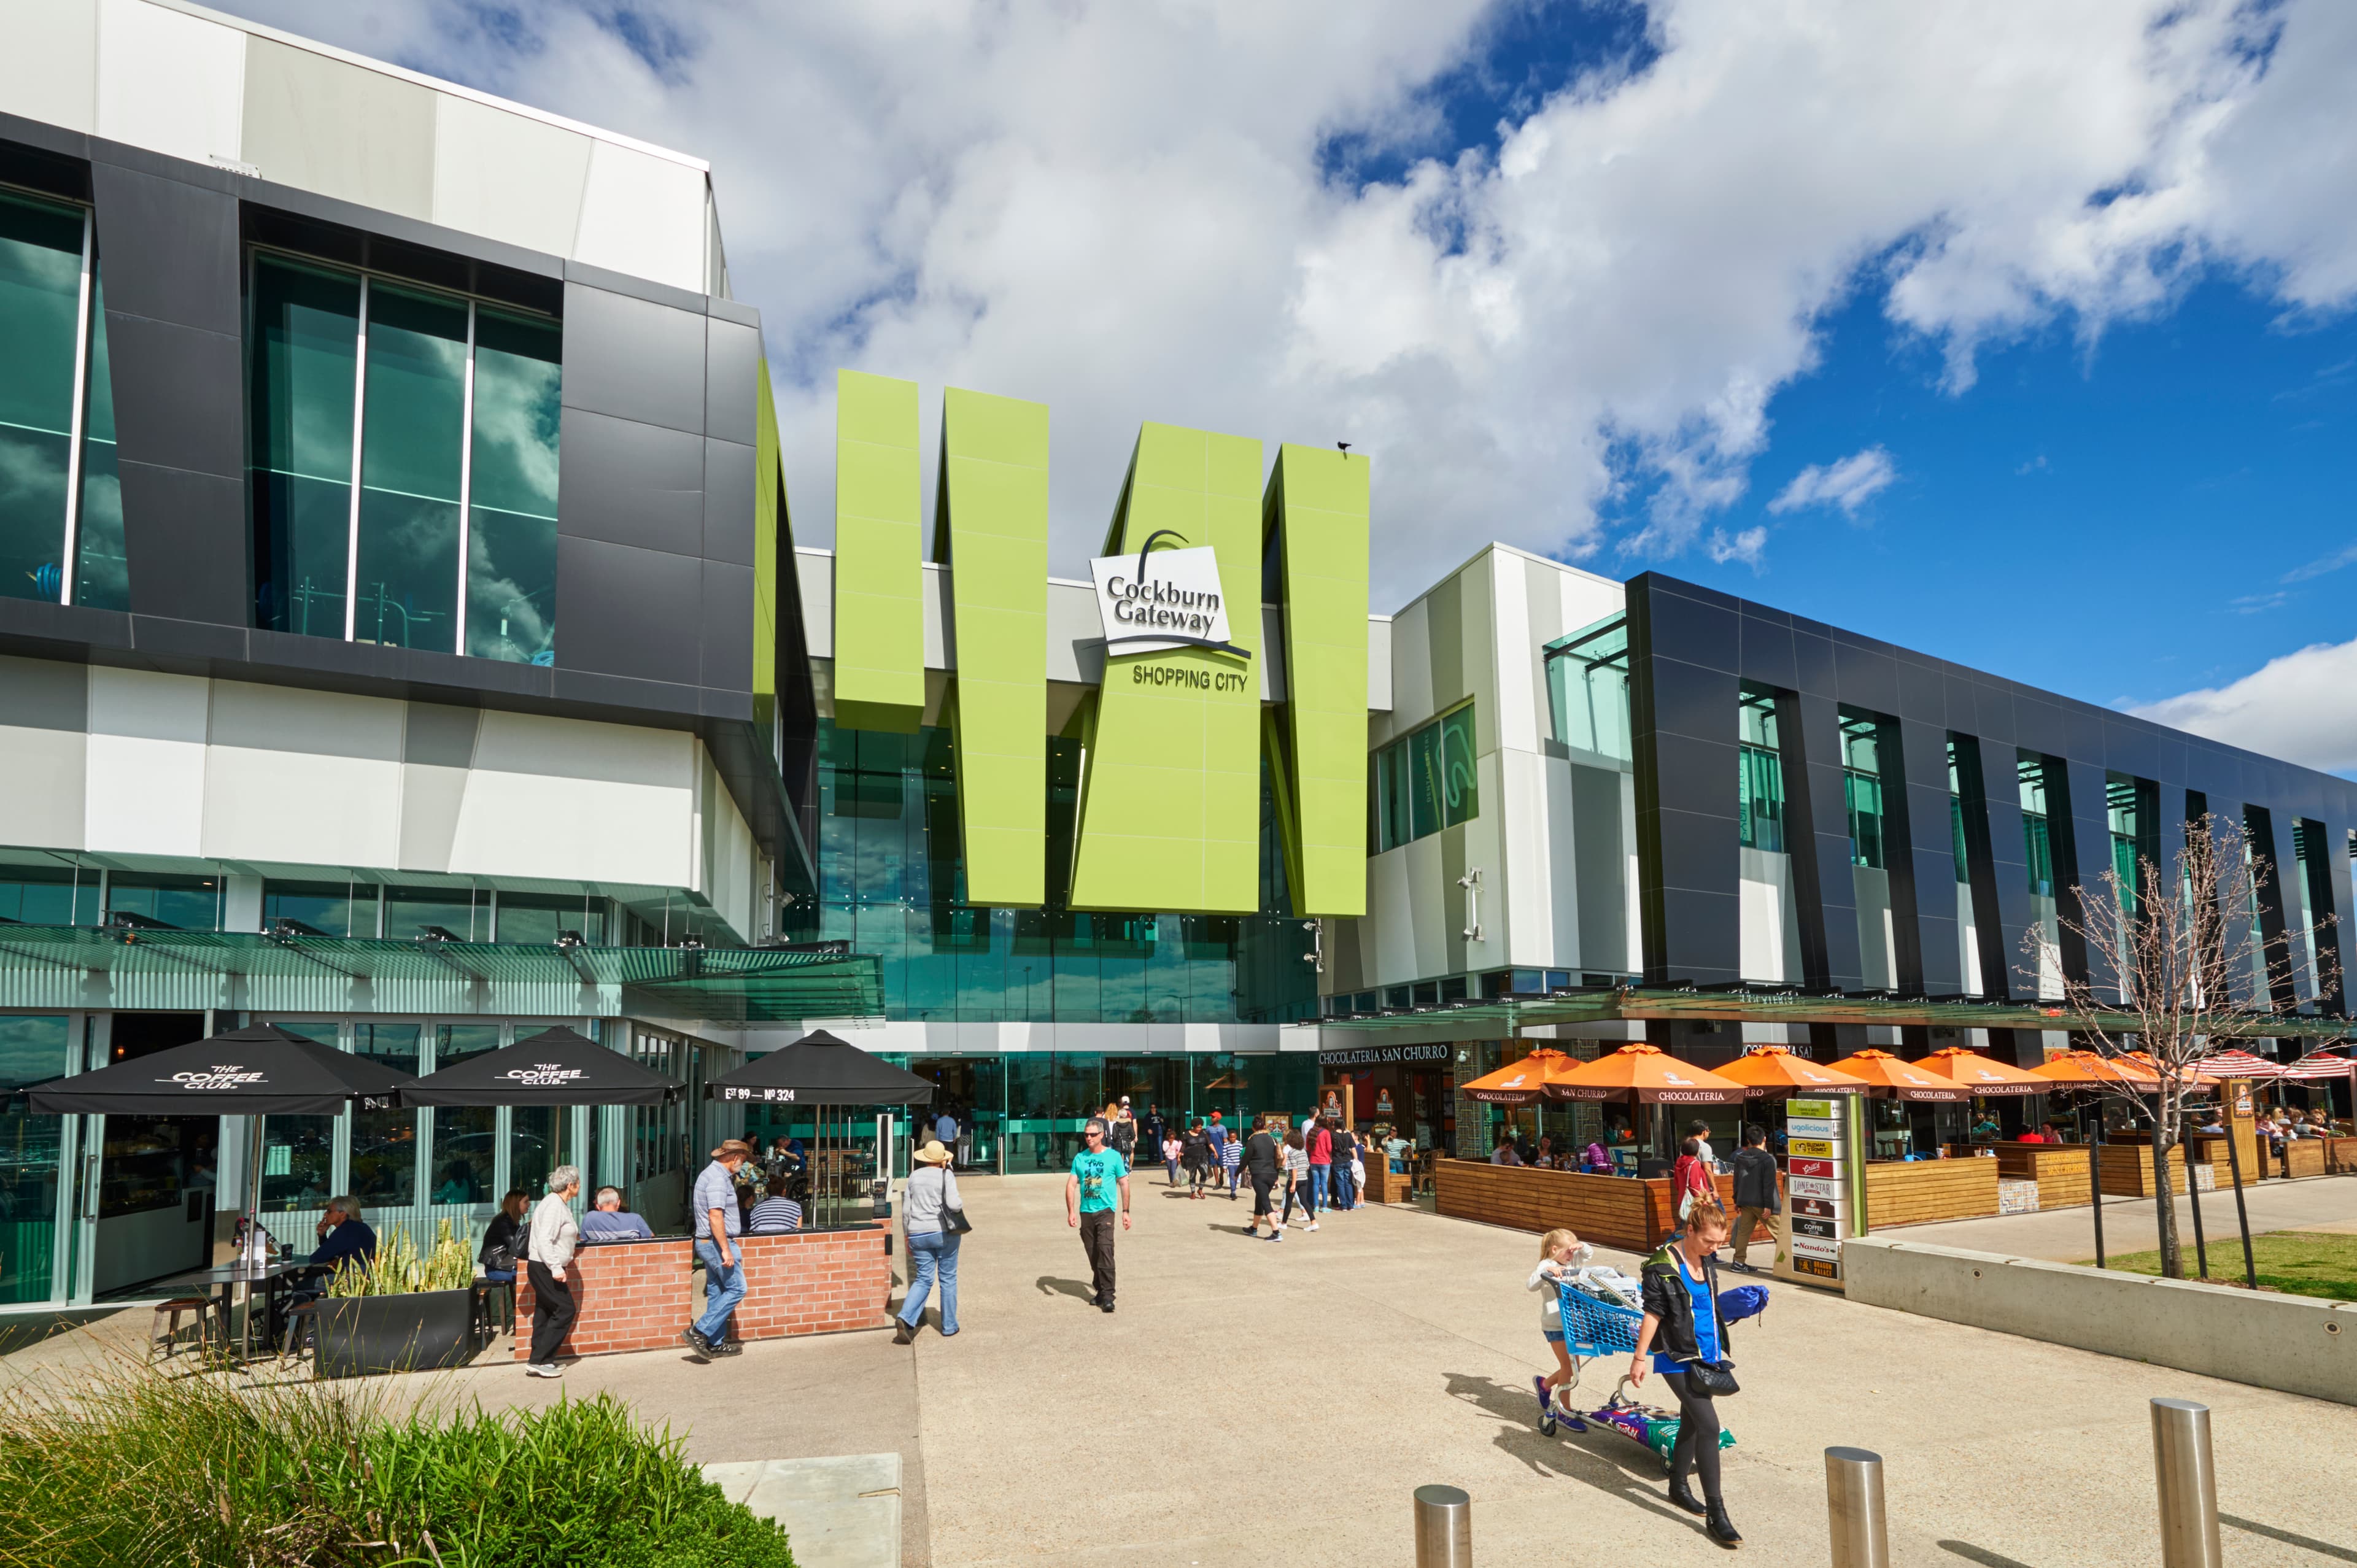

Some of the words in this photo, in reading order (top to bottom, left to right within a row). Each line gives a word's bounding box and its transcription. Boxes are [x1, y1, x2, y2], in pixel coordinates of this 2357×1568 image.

[1107, 576, 1220, 610] Cockburn
[1115, 600, 1215, 638] Gateway
[1134, 665, 1210, 690] SHOPPING
[1215, 673, 1248, 693] CITY
[1320, 1049, 1380, 1065] CHOCOLATERIA
[1382, 1048, 1401, 1062] SAN
[1403, 1045, 1447, 1060] CHURRO
[211, 1065, 244, 1073] THE
[507, 1069, 582, 1079] COFFEE
[172, 1072, 264, 1082] COFFEE
[1561, 1088, 1576, 1097] SAN
[1577, 1089, 1607, 1099] CHURRO
[1744, 1089, 1764, 1097] RRO
[1974, 1084, 2034, 1094] CHOCOLATERIA
[738, 1088, 751, 1100] 89
[776, 1089, 795, 1101] 324
[1477, 1092, 1525, 1102] CHOCOLATERIA
[1658, 1091, 1725, 1101] CHOCOLATERIA
[1910, 1091, 1956, 1100] CHOCOLATERIA
[1792, 1124, 1829, 1133] ugolicious
[1794, 1180, 1810, 1192] LONE
[1814, 1183, 1830, 1196] STAR
[1798, 1242, 1830, 1253] Nando's
[1813, 1261, 1832, 1270] DRAGON
[1813, 1268, 1832, 1277] PALACE
